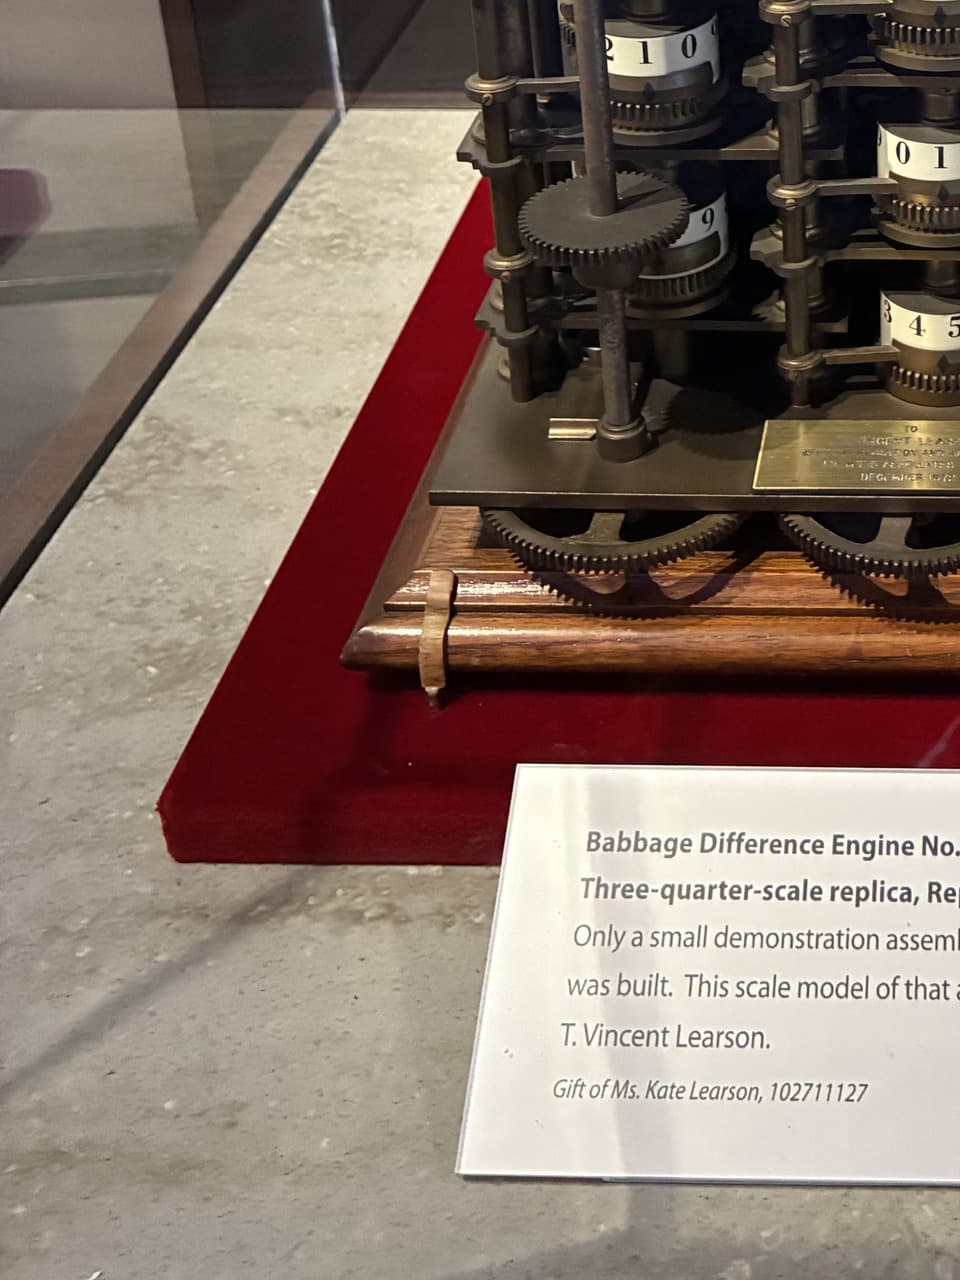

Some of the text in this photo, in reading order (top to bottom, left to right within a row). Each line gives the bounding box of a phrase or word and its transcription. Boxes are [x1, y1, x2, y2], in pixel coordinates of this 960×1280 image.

[637, 40, 653, 65] 1
[681, 33, 698, 59] 0
[895, 140, 911, 165] 0
[933, 145, 949, 169] 1
[908, 314, 926, 337] 4
[586, 829, 693, 860] Babbage
[699, 831, 825, 857] Difference
[831, 833, 915, 862] Engine
[921, 834, 960, 858] No.
[580, 875, 824, 906] Three-quarter-scale
[829, 879, 920, 909] replica,
[573, 923, 627, 954] Only
[630, 930, 644, 948] a
[649, 924, 709, 949] small
[713, 924, 880, 951] demonstration
[567, 977, 611, 997] was
[616, 971, 674, 998] built.
[683, 972, 730, 998] This
[735, 973, 791, 999] scale
[797, 974, 870, 1000] model
[875, 974, 901, 1001] of
[903, 975, 951, 1001] that
[560, 1022, 771, 1050] T. Vincent Learson.
[552, 1077, 870, 1105] Gift of Ms. Kate Learson, 102711127
